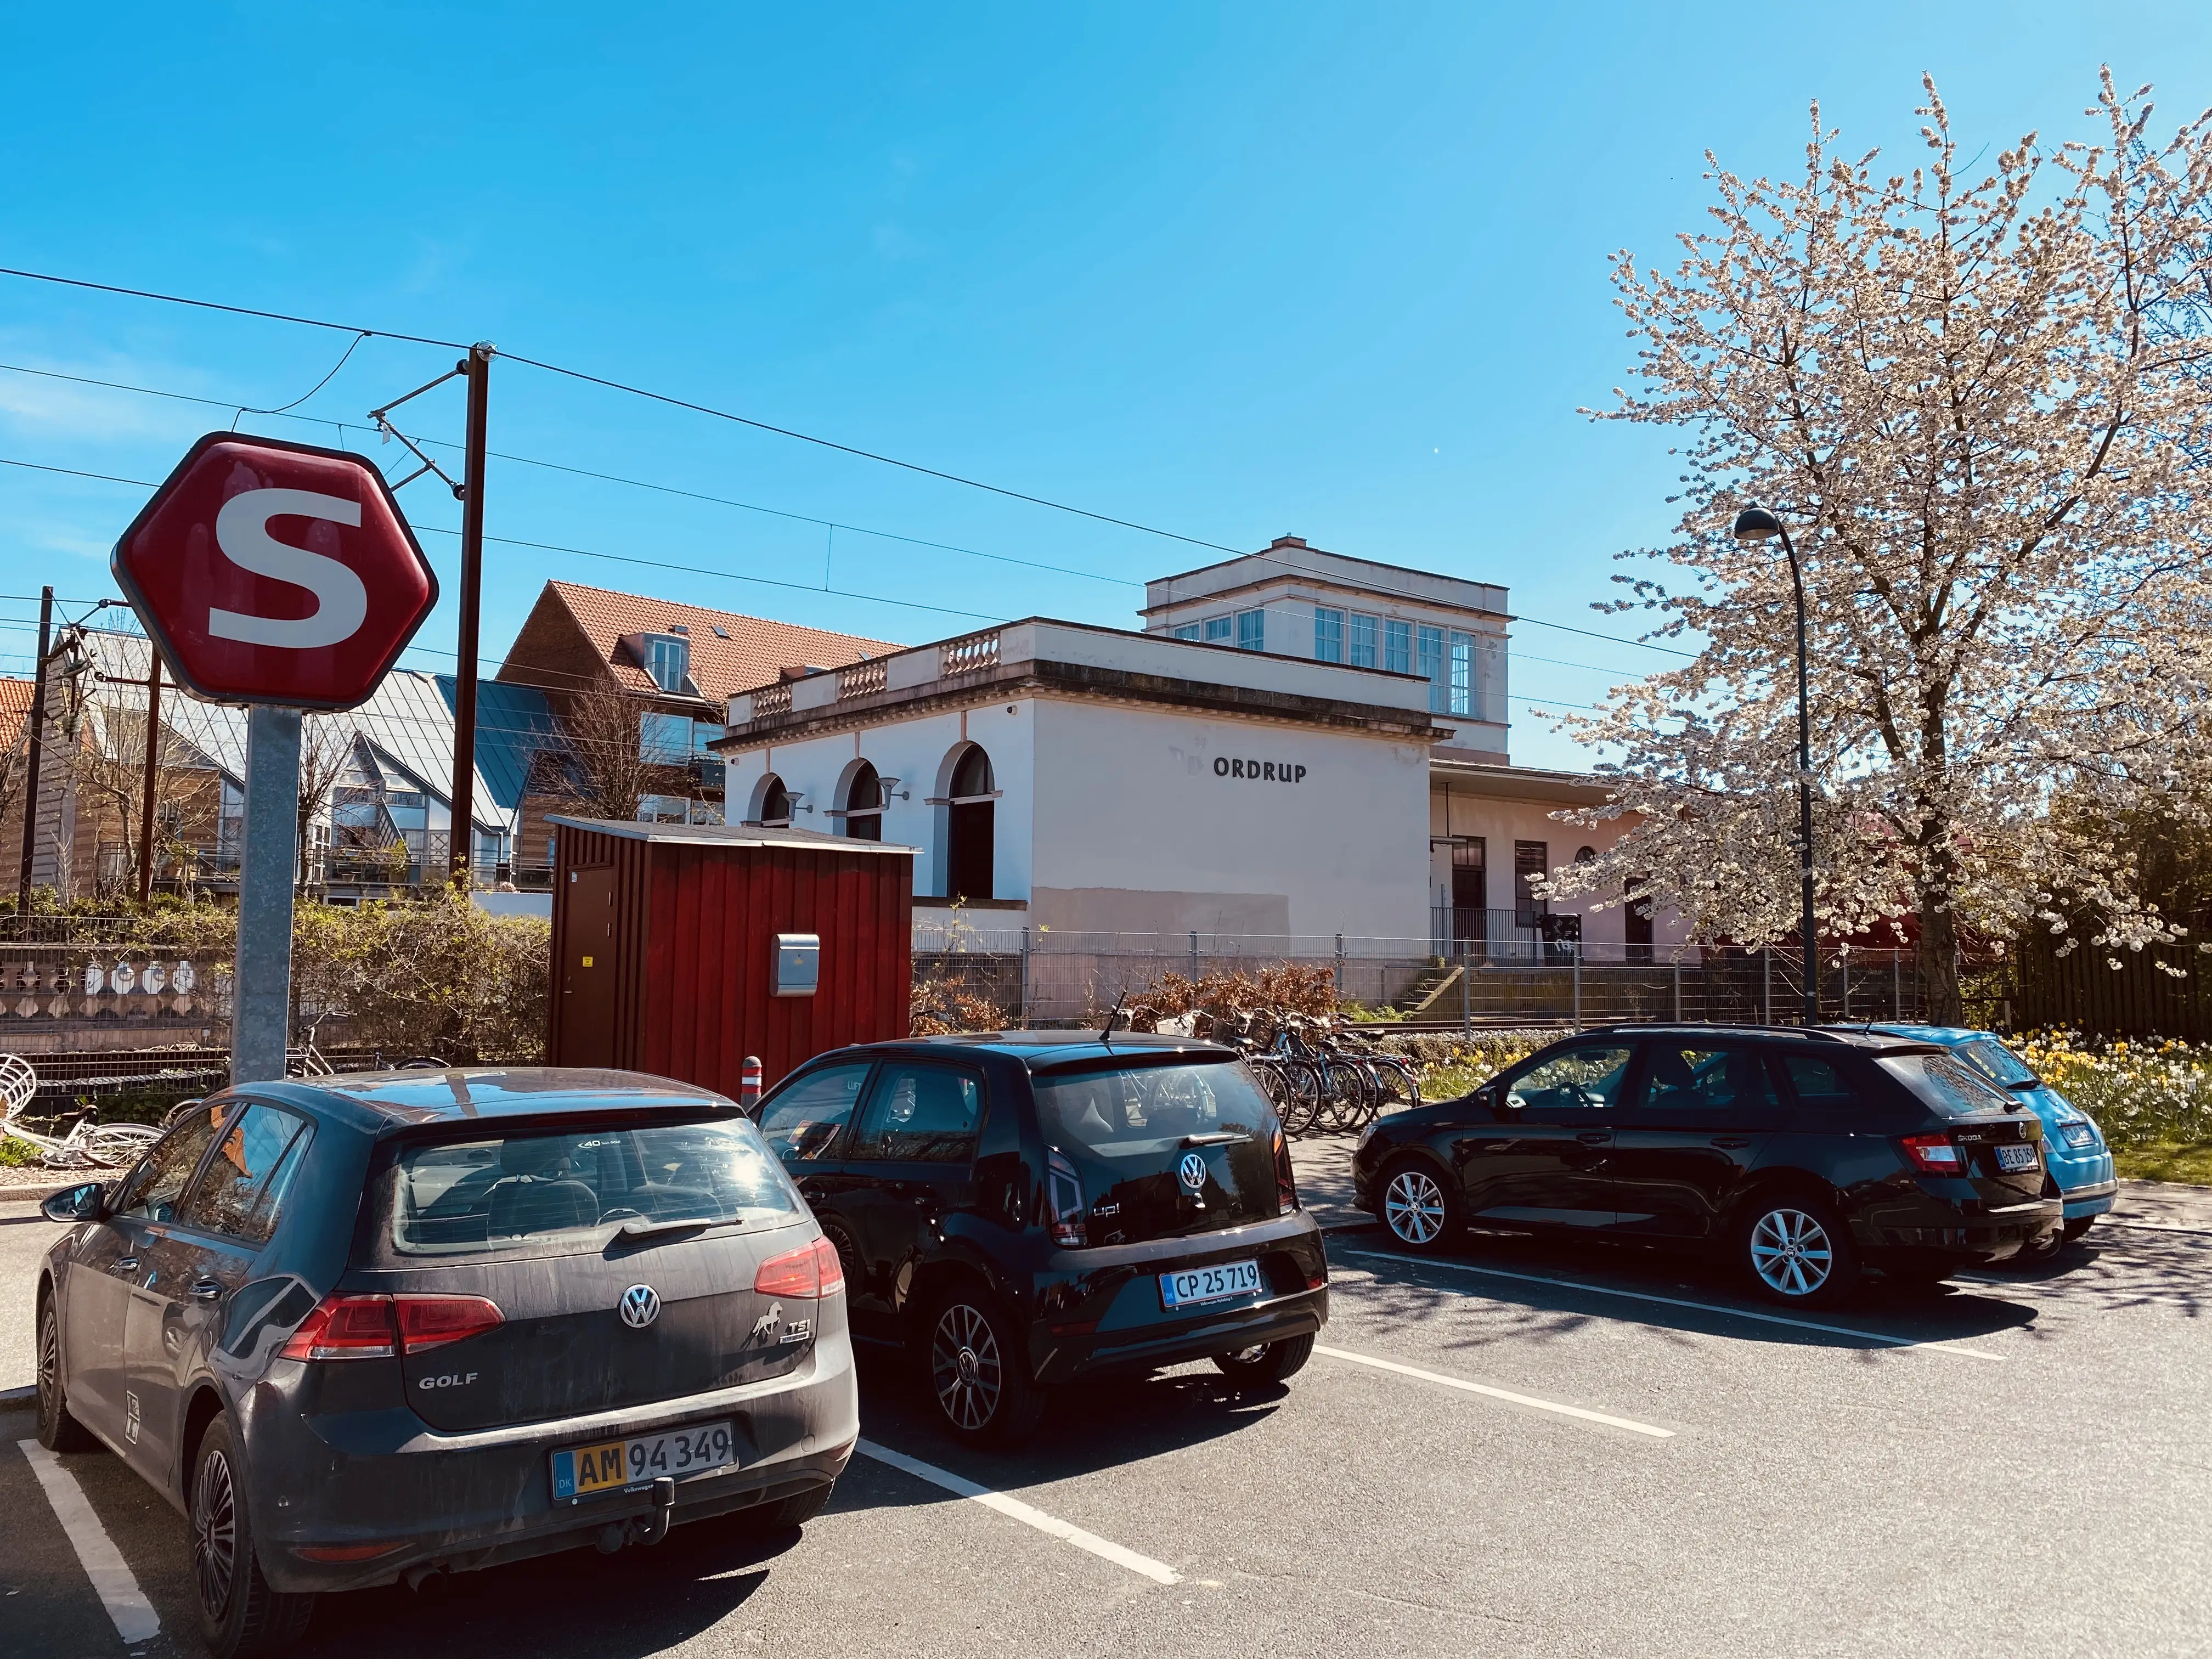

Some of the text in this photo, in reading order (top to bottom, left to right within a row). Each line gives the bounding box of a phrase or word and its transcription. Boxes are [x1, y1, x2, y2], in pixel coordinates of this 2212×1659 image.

[208, 488, 367, 648] S
[1214, 757, 1307, 783] ORDRUP
[2001, 1149, 2015, 1165] BE
[2013, 1148, 2024, 1164] 85
[1093, 1202, 1120, 1217] up!
[1176, 1264, 1257, 1298] CP 25 719
[788, 1318, 811, 1334] TSI
[419, 1372, 478, 1390] GOLF
[578, 1429, 729, 1486] AM 94 349
[558, 1477, 572, 1489] DK
[623, 1484, 654, 1494] Volkswagen
